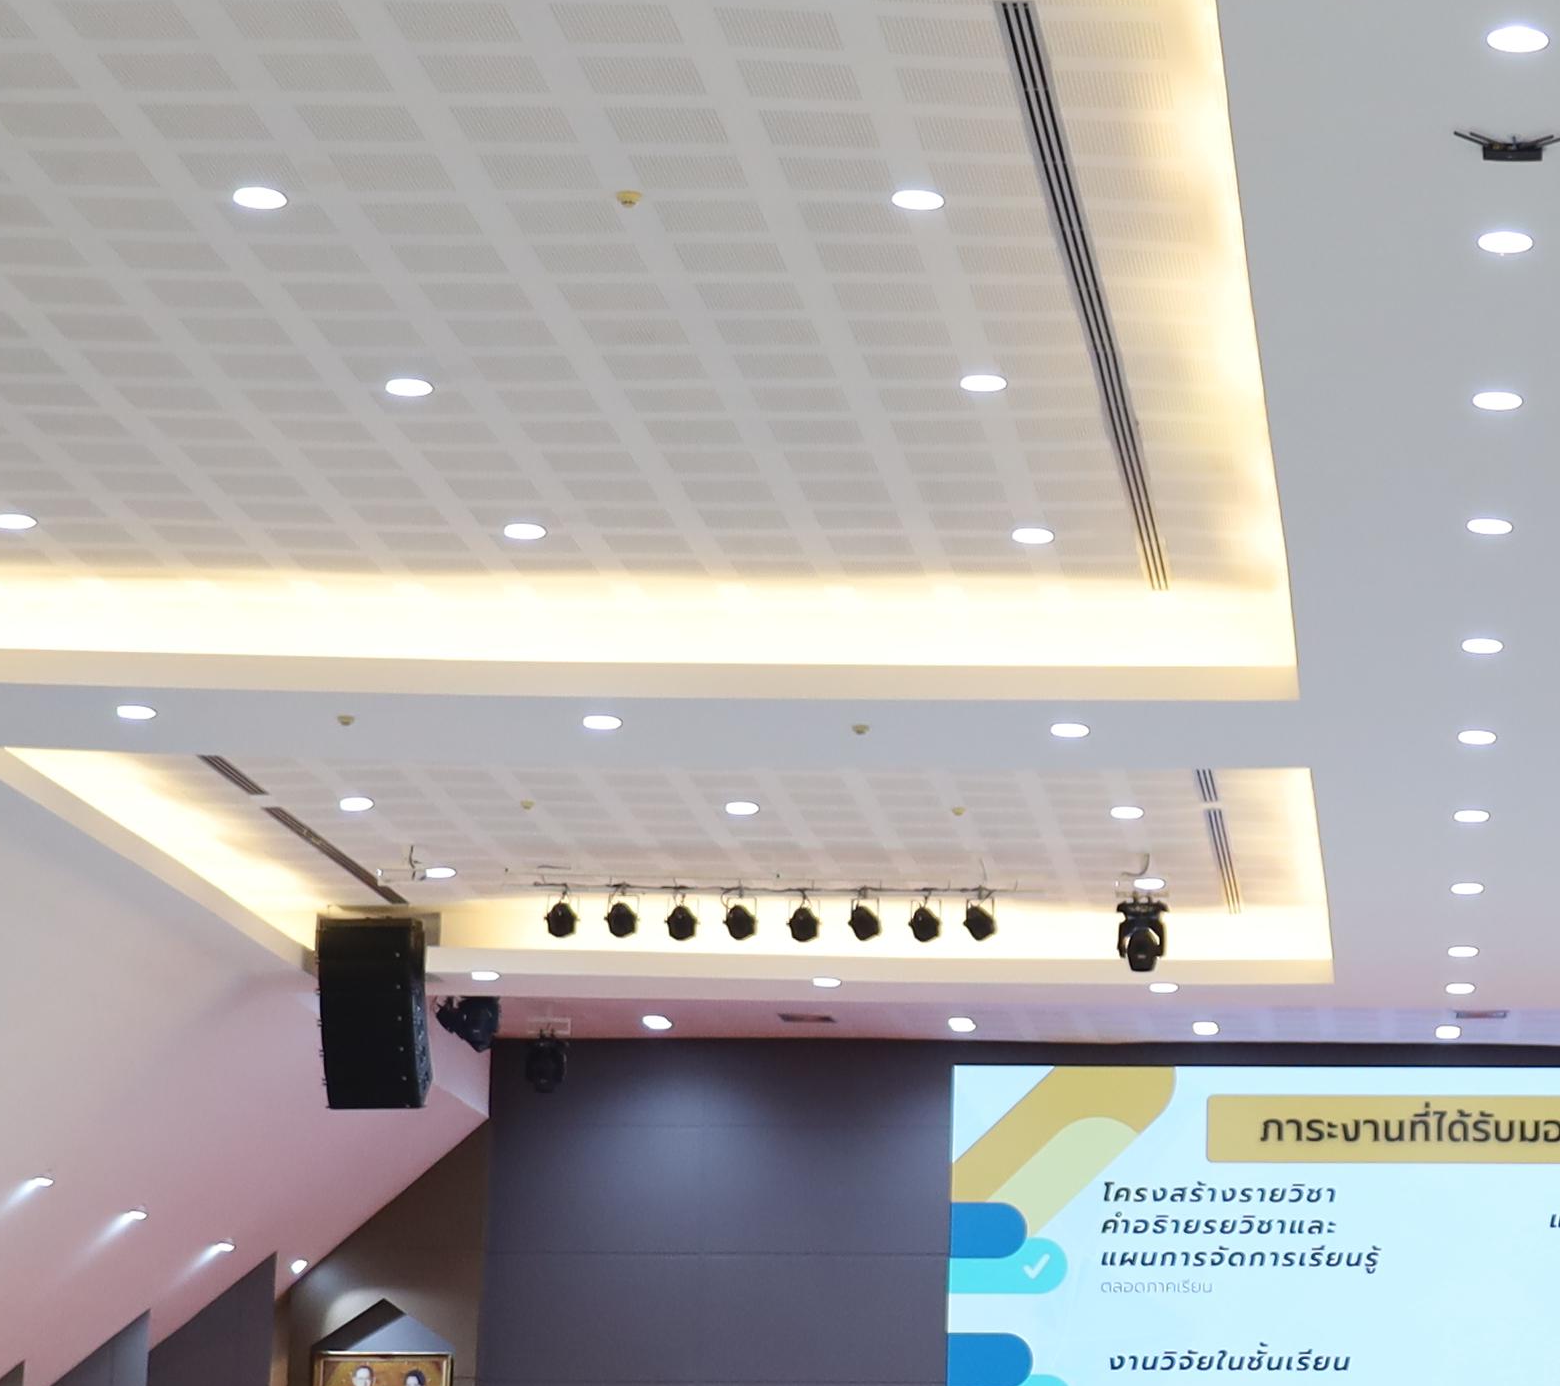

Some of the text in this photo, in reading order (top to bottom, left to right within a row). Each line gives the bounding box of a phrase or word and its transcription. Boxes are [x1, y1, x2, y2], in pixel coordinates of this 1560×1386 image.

[1102, 1181, 1336, 1203] โครงสร้างรายวิชา
[1101, 1245, 1381, 1274] แผนการจัดการเรียนรู้
[1101, 1279, 1213, 1293] ตลอดภาคเรียน
[1109, 1342, 1351, 1371] งานวิจัยในชั้นเรียน
